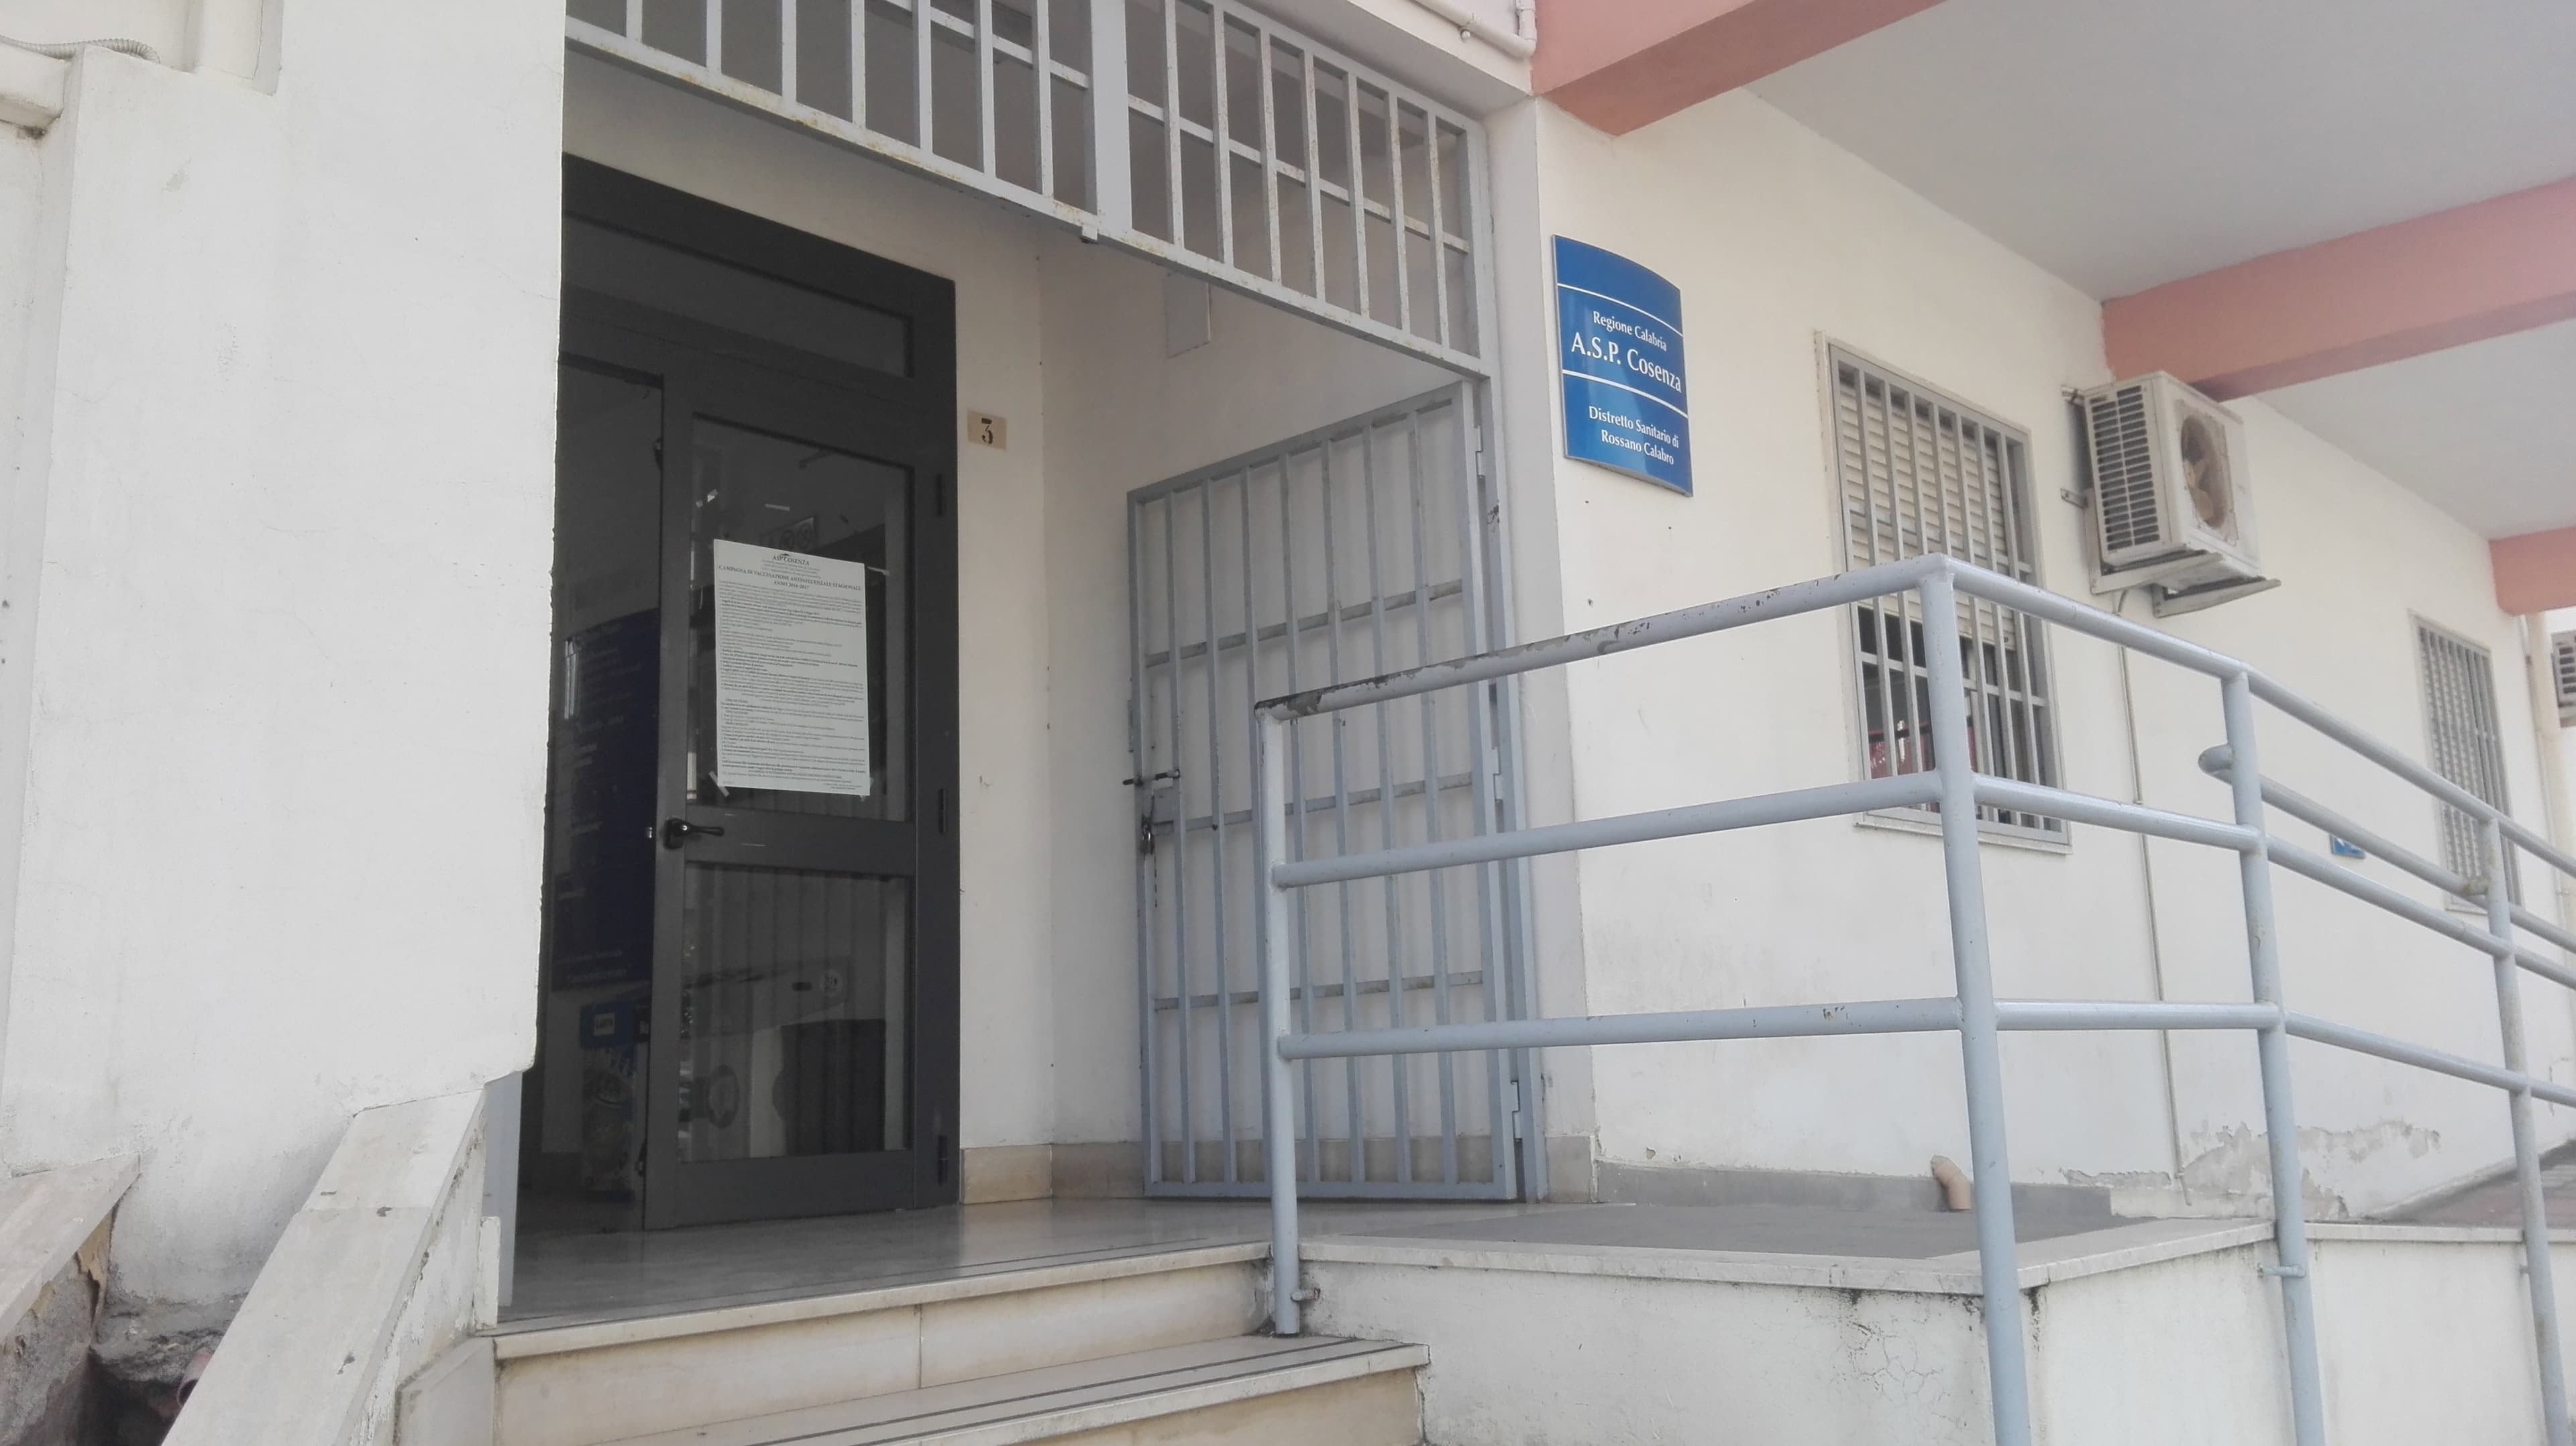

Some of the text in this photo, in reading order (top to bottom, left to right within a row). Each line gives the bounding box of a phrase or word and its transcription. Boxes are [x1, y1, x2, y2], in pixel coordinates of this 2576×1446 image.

[1593, 311, 1668, 352] Regione Calabria
[1570, 331, 1682, 394] A.S.P. Cosenza
[981, 417, 994, 444] 3
[1589, 405, 1679, 449] Distretto Sanitario di
[1601, 429, 1674, 465] Rossano Calabro
